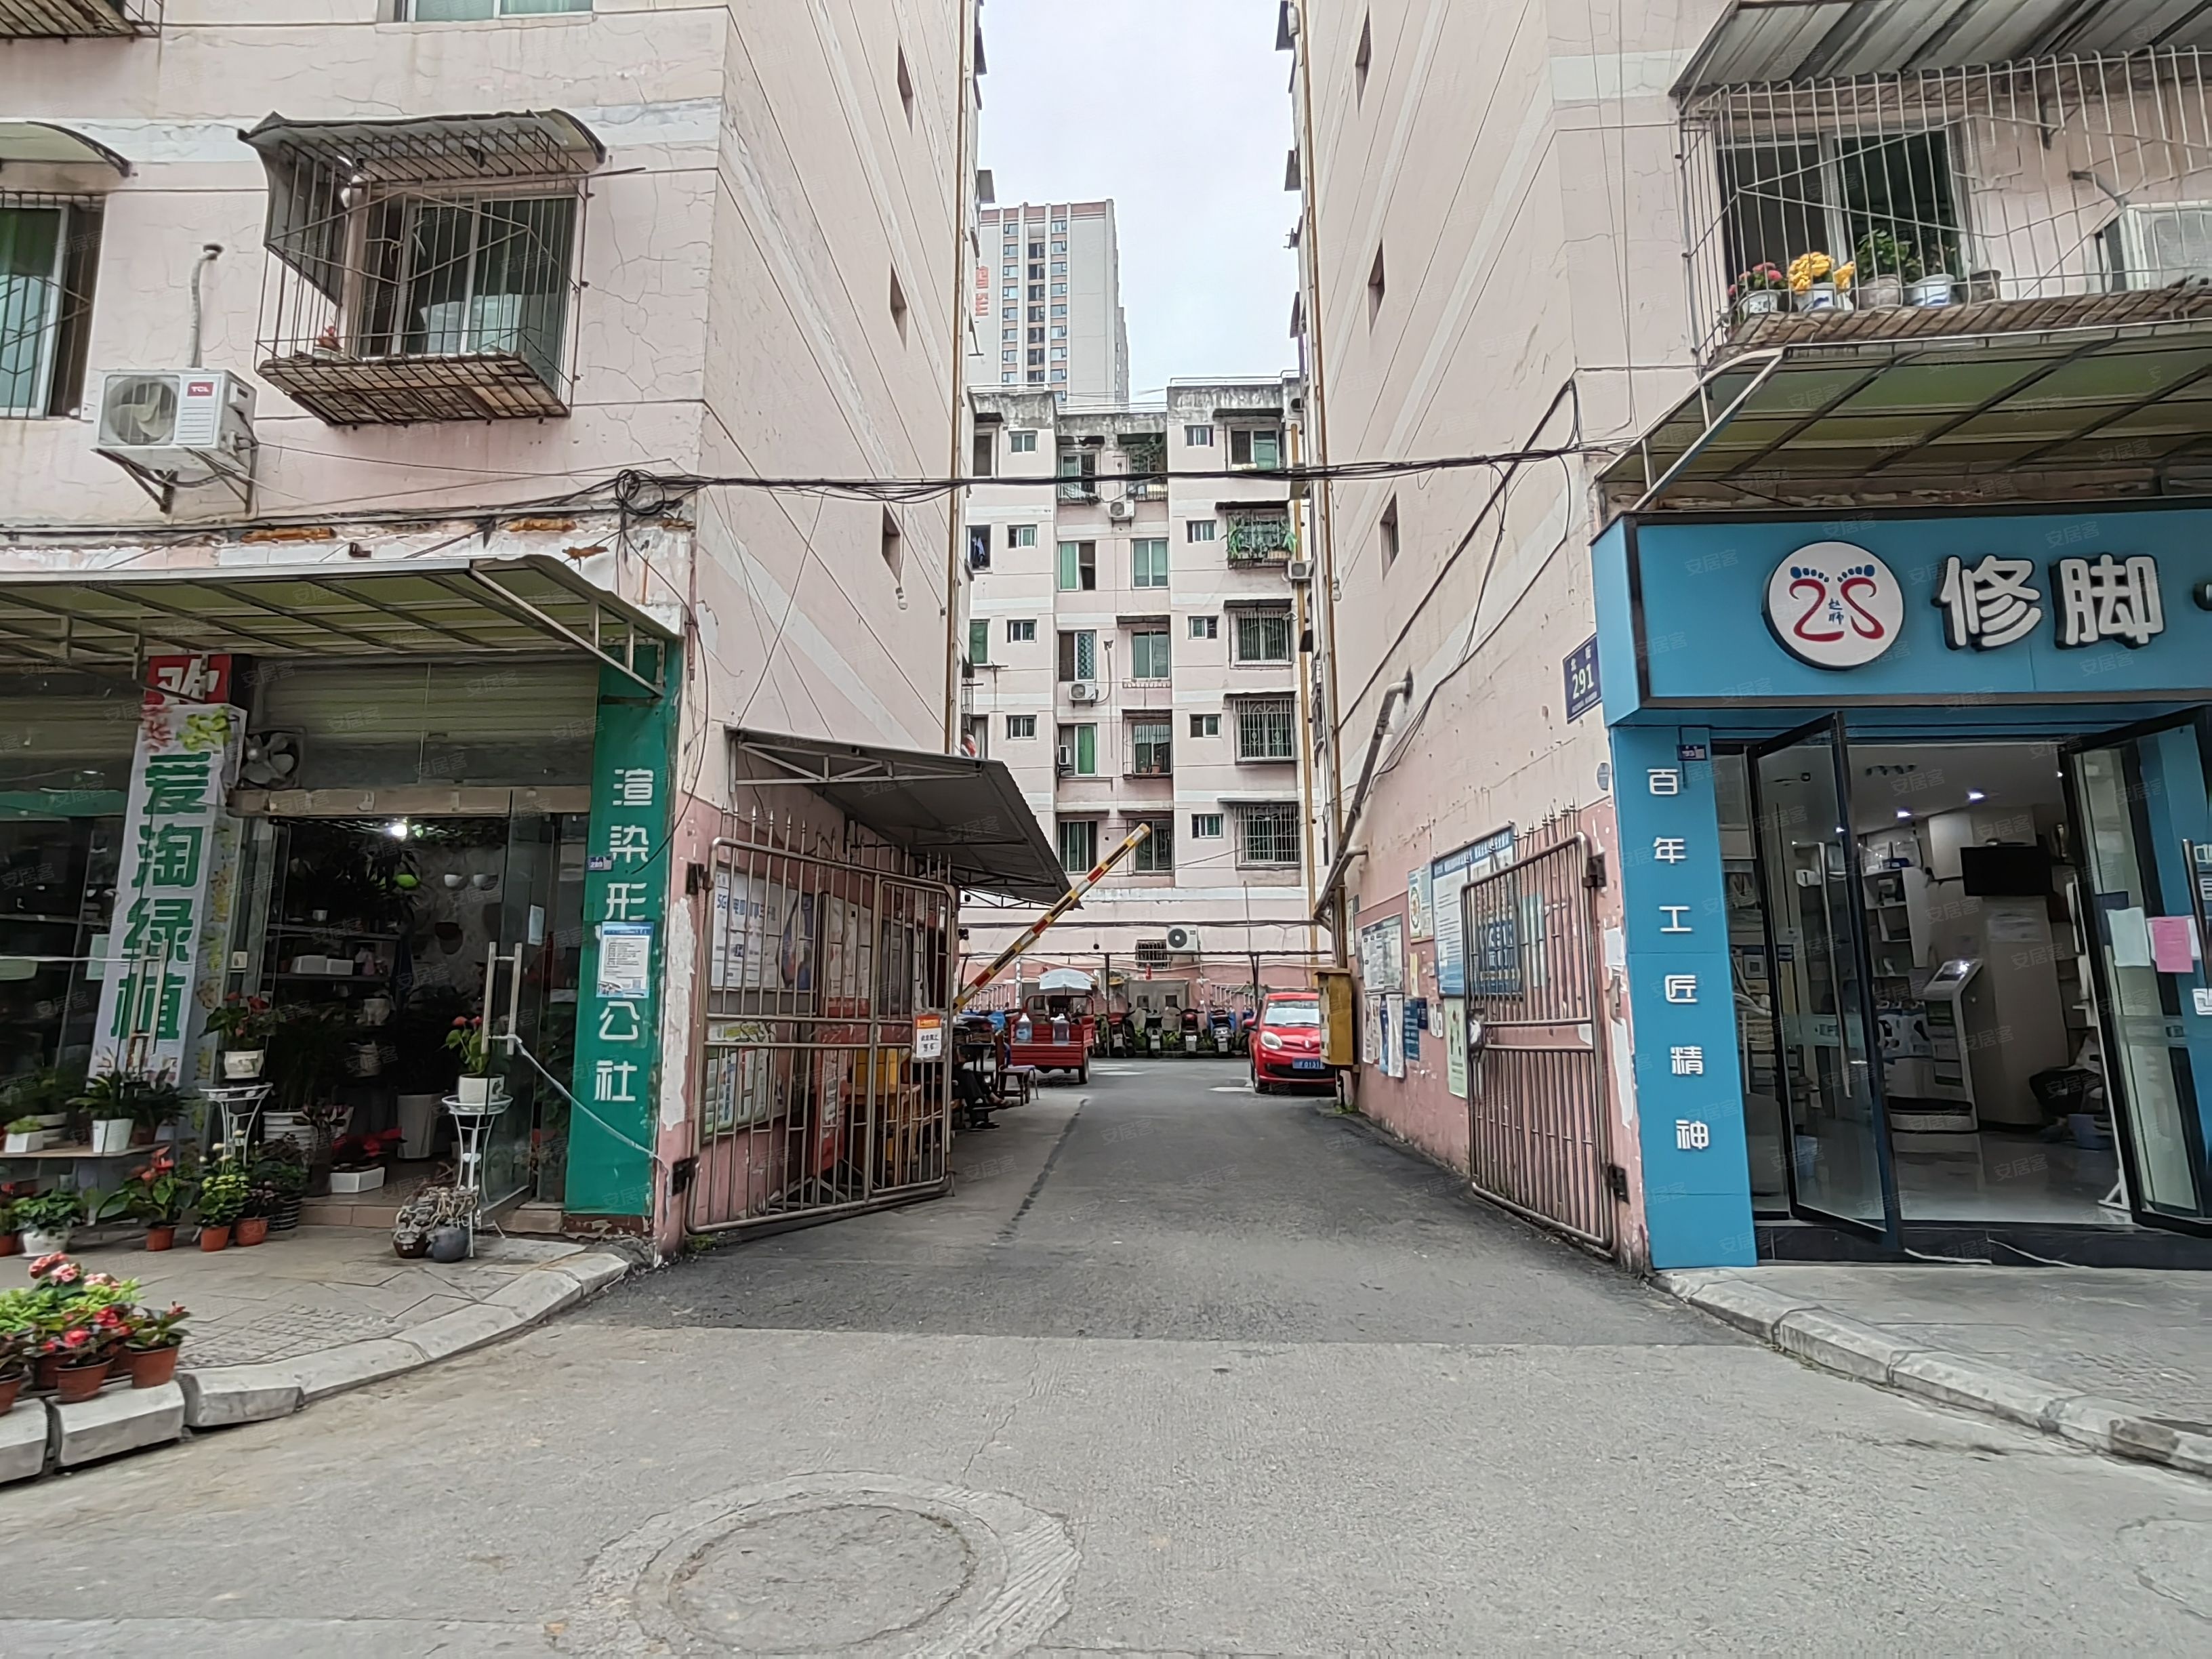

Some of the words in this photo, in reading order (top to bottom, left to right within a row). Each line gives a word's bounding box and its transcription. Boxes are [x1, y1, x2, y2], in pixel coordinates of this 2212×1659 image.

[1572, 663, 1595, 699] 291
[1940, 554, 2164, 647] 修脚
[110, 751, 211, 1040] 爱淘绿植
[594, 768, 654, 1101] 渲染形公社
[1647, 769, 1709, 1150] 百年工匠精神
